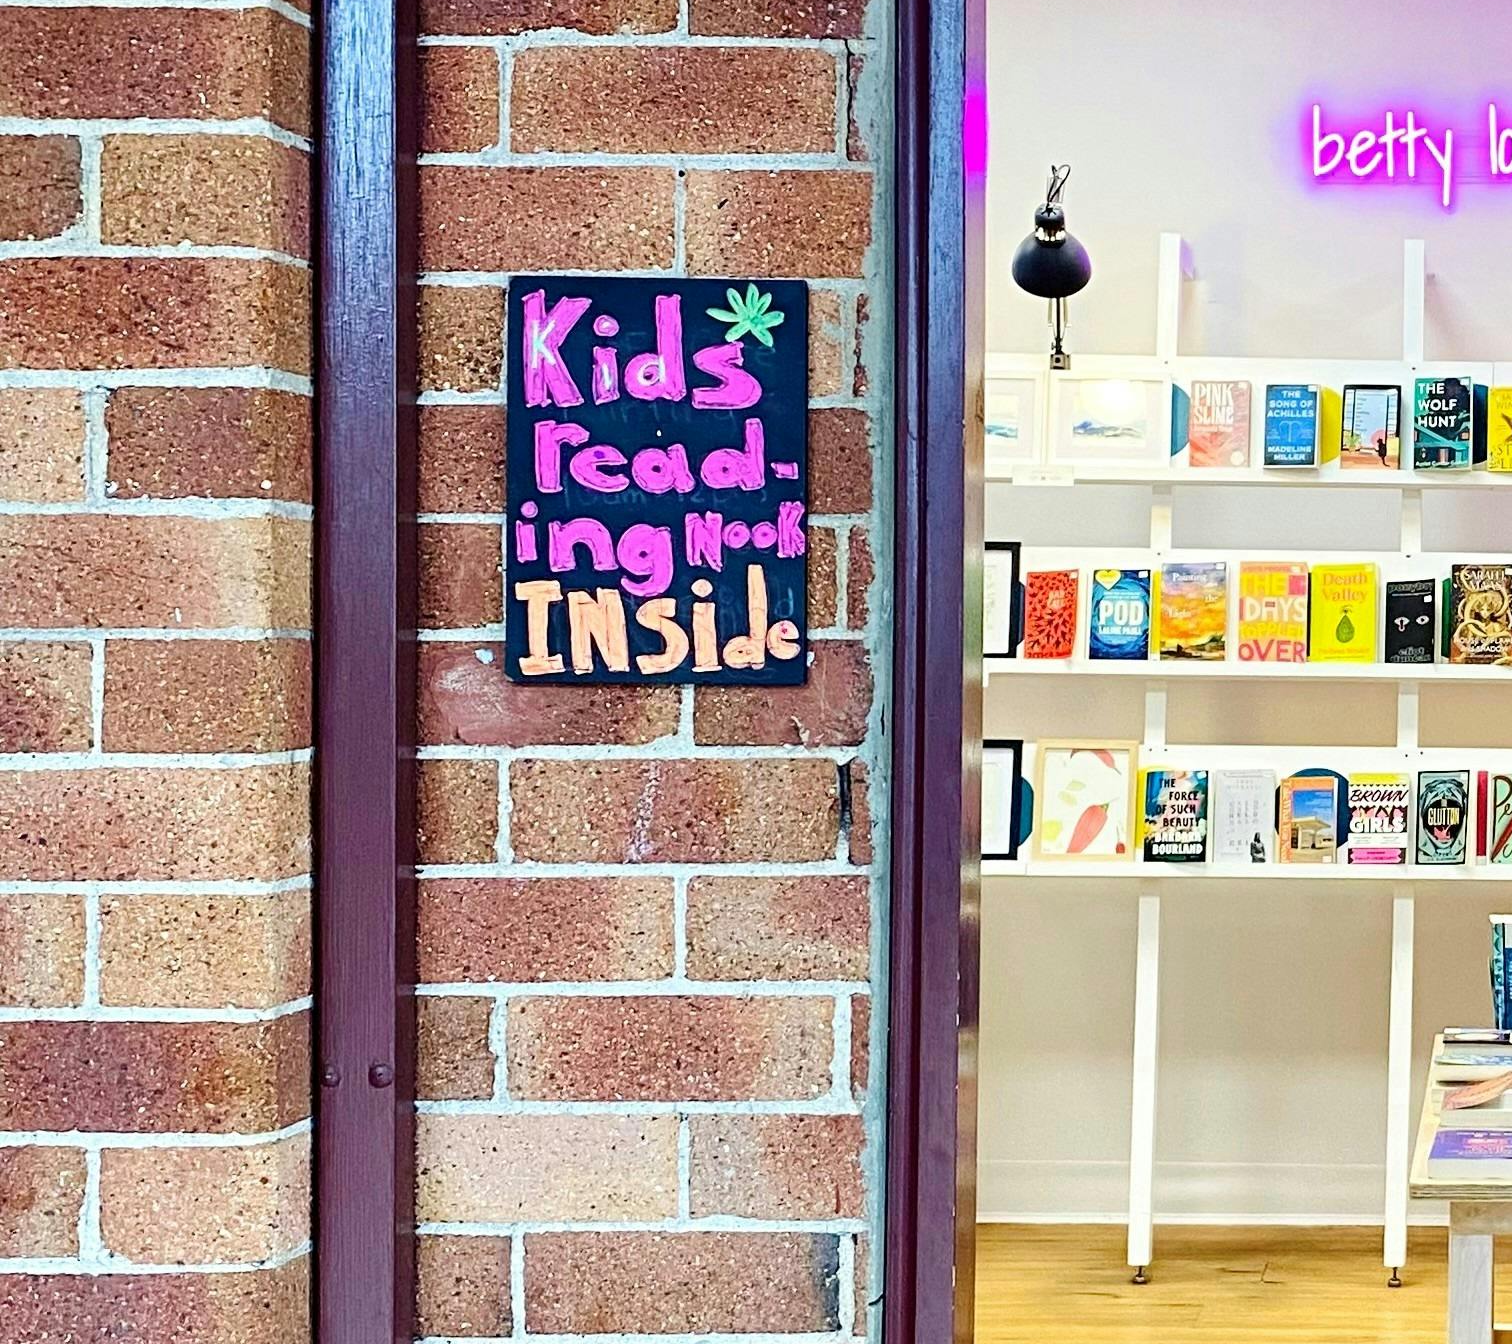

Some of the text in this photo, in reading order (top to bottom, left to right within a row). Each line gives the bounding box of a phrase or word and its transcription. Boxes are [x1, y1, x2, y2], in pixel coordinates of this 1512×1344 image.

[1312, 103, 1454, 207] betty
[521, 288, 764, 410] Kids
[1194, 383, 1235, 407] PINK
[1281, 390, 1301, 398] THE
[1417, 383, 1446, 395] THE
[1269, 399, 1314, 408] SONG OF
[1417, 399, 1458, 412] WOLF
[1267, 409, 1315, 418] ACHILLES
[1417, 415, 1457, 428] HUNT
[534, 417, 800, 494] read-
[514, 500, 674, 598] ing
[1322, 572, 1368, 586] Death
[1322, 587, 1368, 606] Valley
[1098, 599, 1145, 626] POD
[1244, 597, 1306, 623] DAYS
[1238, 638, 1306, 663] OVER
[1159, 778, 1176, 788] THE
[1168, 791, 1199, 801] FORCE
[1349, 789, 1409, 803] BROWN
[1156, 804, 1197, 814] OF SUCH
[1162, 817, 1200, 827] BEAUTY
[1427, 807, 1460, 826] GLUTTON
[1349, 816, 1405, 834] GIRLS
[1152, 843, 1204, 855] BOURLAND
